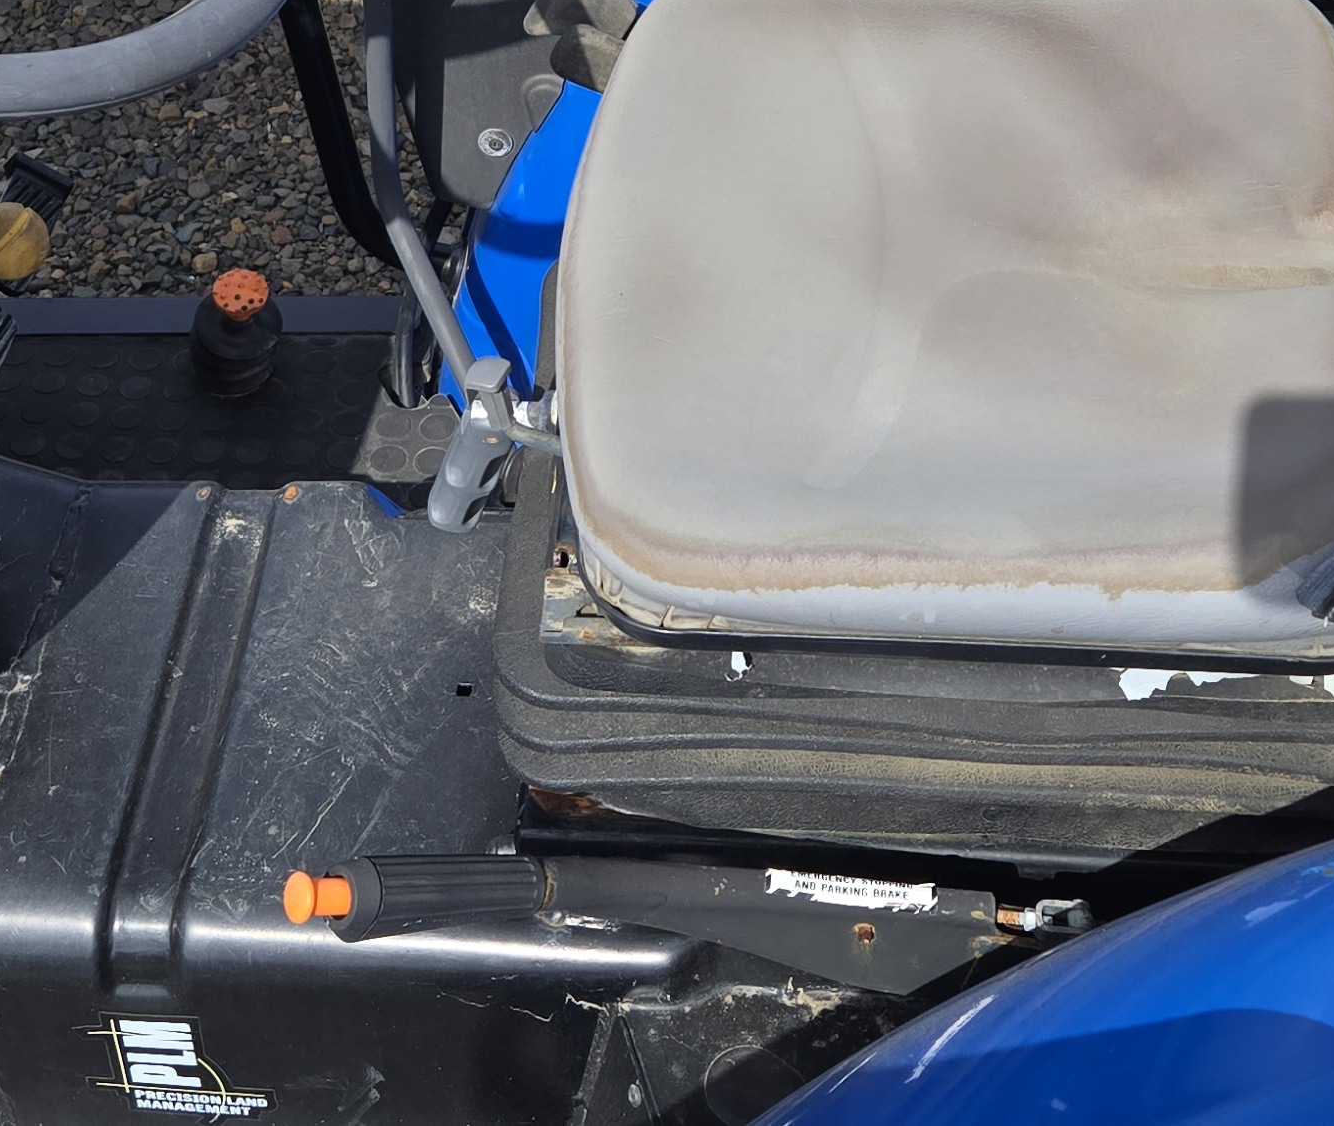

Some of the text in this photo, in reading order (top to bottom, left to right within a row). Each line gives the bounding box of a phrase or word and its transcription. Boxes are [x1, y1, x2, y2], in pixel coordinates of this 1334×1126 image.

[794, 880, 909, 900] AND PARKING BRAKE
[119, 1019, 202, 1087] PLM
[134, 1090, 268, 1108] PRECISION LAND
[136, 1099, 251, 1116] MANAGEMENT
